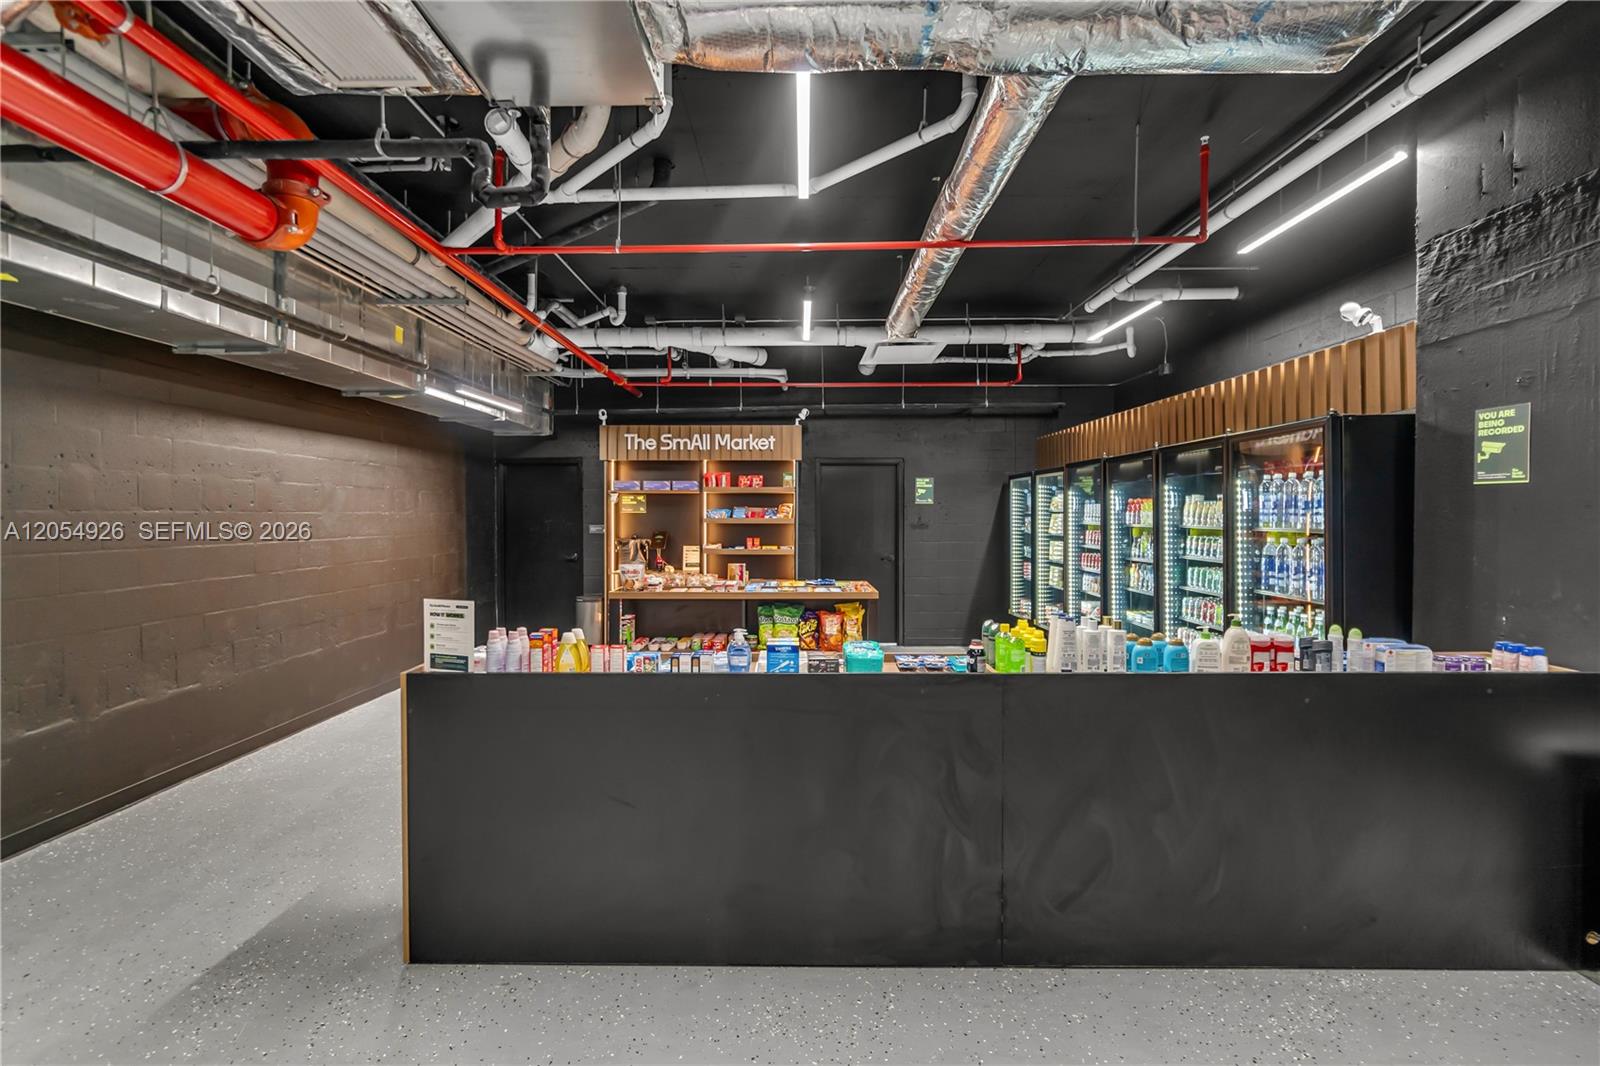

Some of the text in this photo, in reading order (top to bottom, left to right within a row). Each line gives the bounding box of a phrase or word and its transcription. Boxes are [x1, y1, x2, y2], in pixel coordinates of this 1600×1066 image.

[1478, 408, 1516, 420] YOU ARE
[1478, 419, 1505, 429] BEING
[1478, 425, 1525, 437] RECORDED
[624, 433, 776, 451] The SmAll Market
